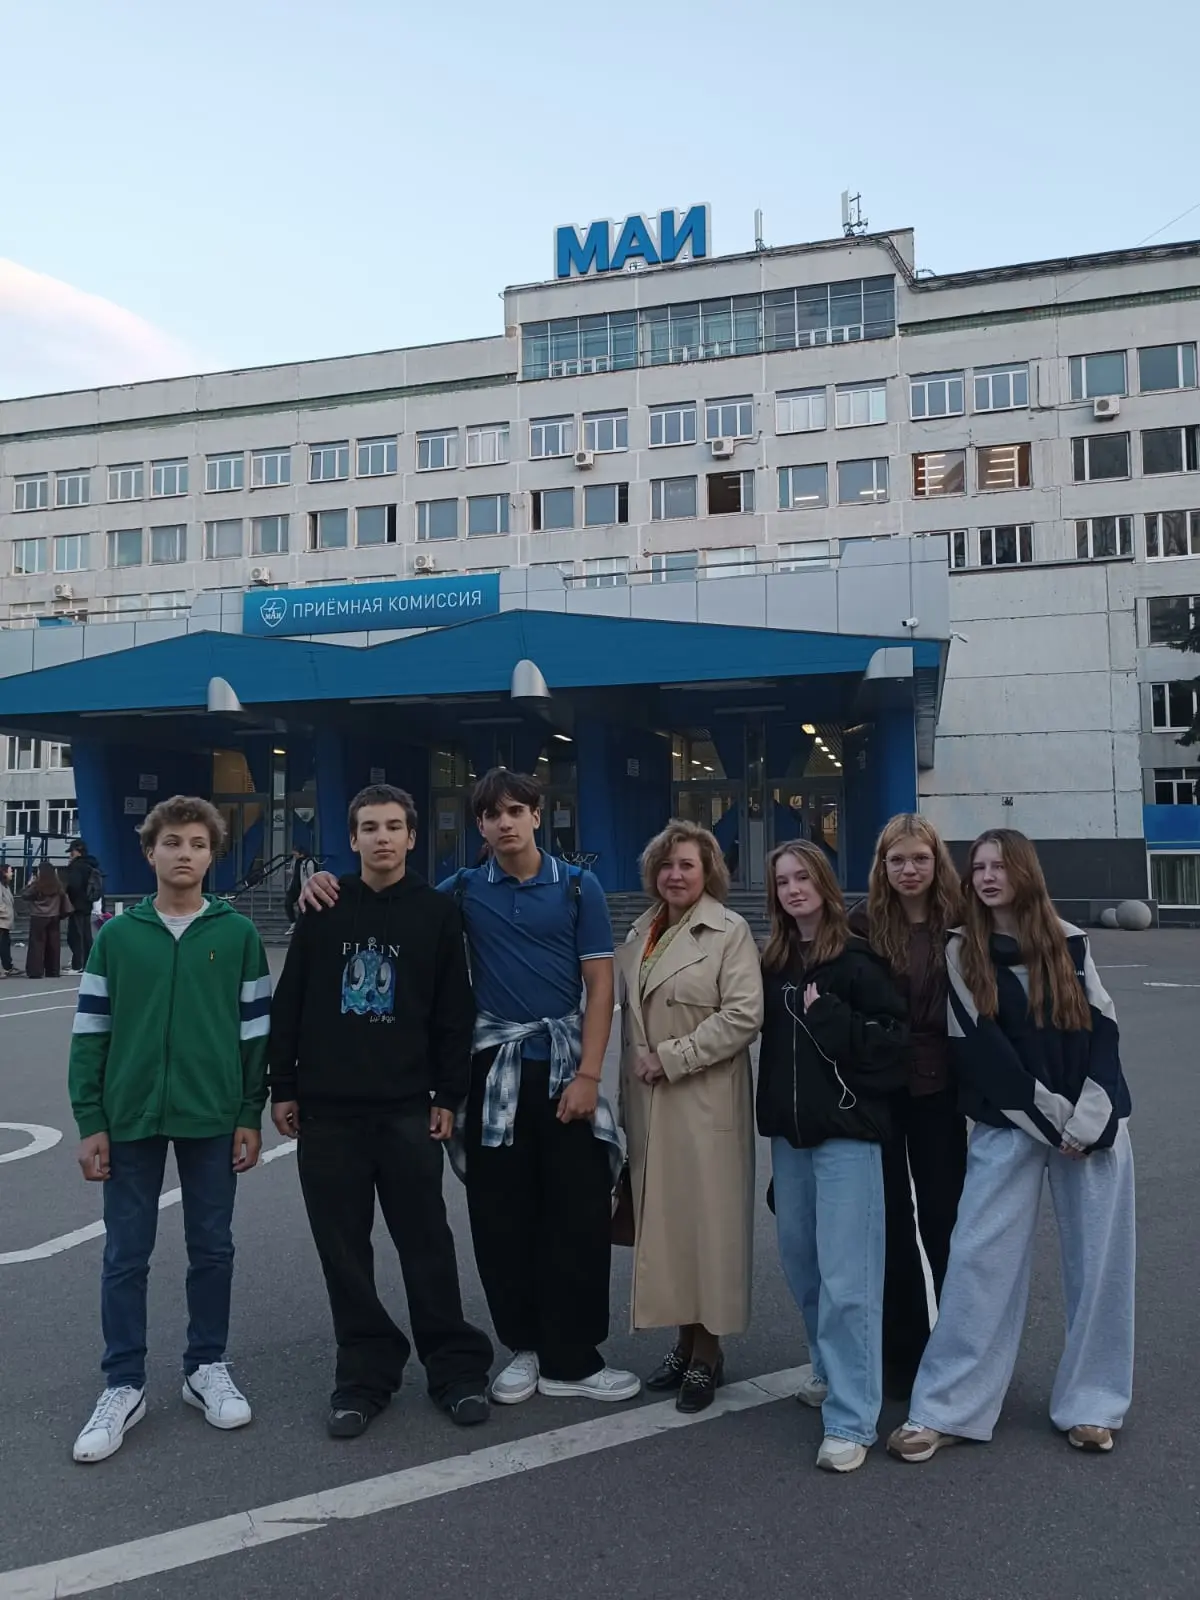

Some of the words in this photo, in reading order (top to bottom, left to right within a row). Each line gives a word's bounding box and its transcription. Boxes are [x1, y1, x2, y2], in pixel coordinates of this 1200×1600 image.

[556, 204, 707, 278] МАИ
[292, 597, 382, 618] ПРИЁМНАЯ
[388, 590, 482, 611] КОМИССИЯ
